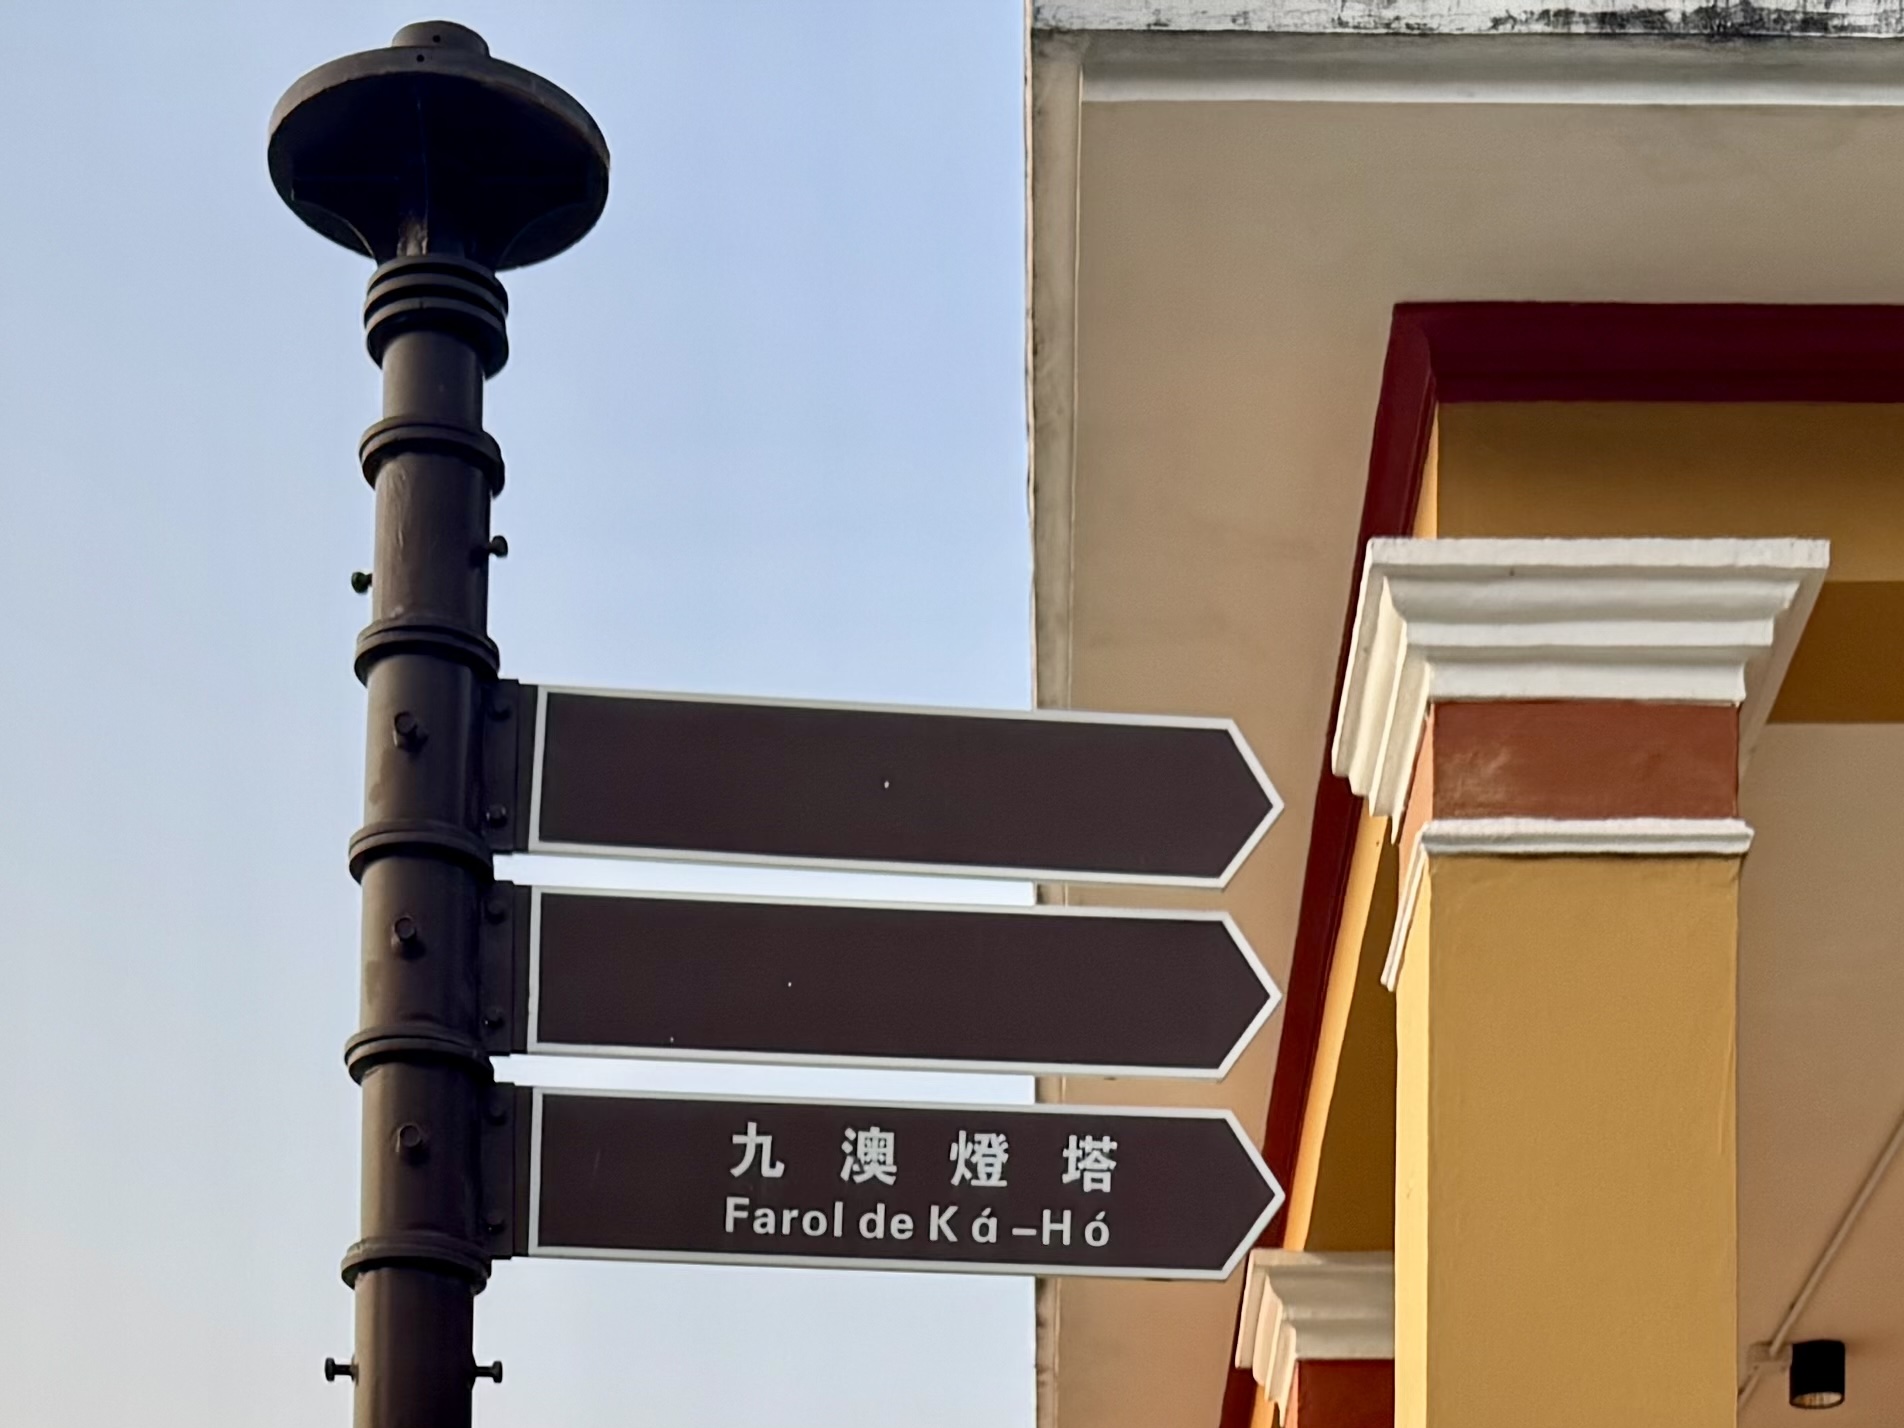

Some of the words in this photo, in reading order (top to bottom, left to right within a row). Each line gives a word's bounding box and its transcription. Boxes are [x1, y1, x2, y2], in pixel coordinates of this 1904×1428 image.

[729, 1121, 1118, 1193] 九澳燈塔
[724, 1195, 844, 1238] Farol
[858, 1202, 915, 1240] de
